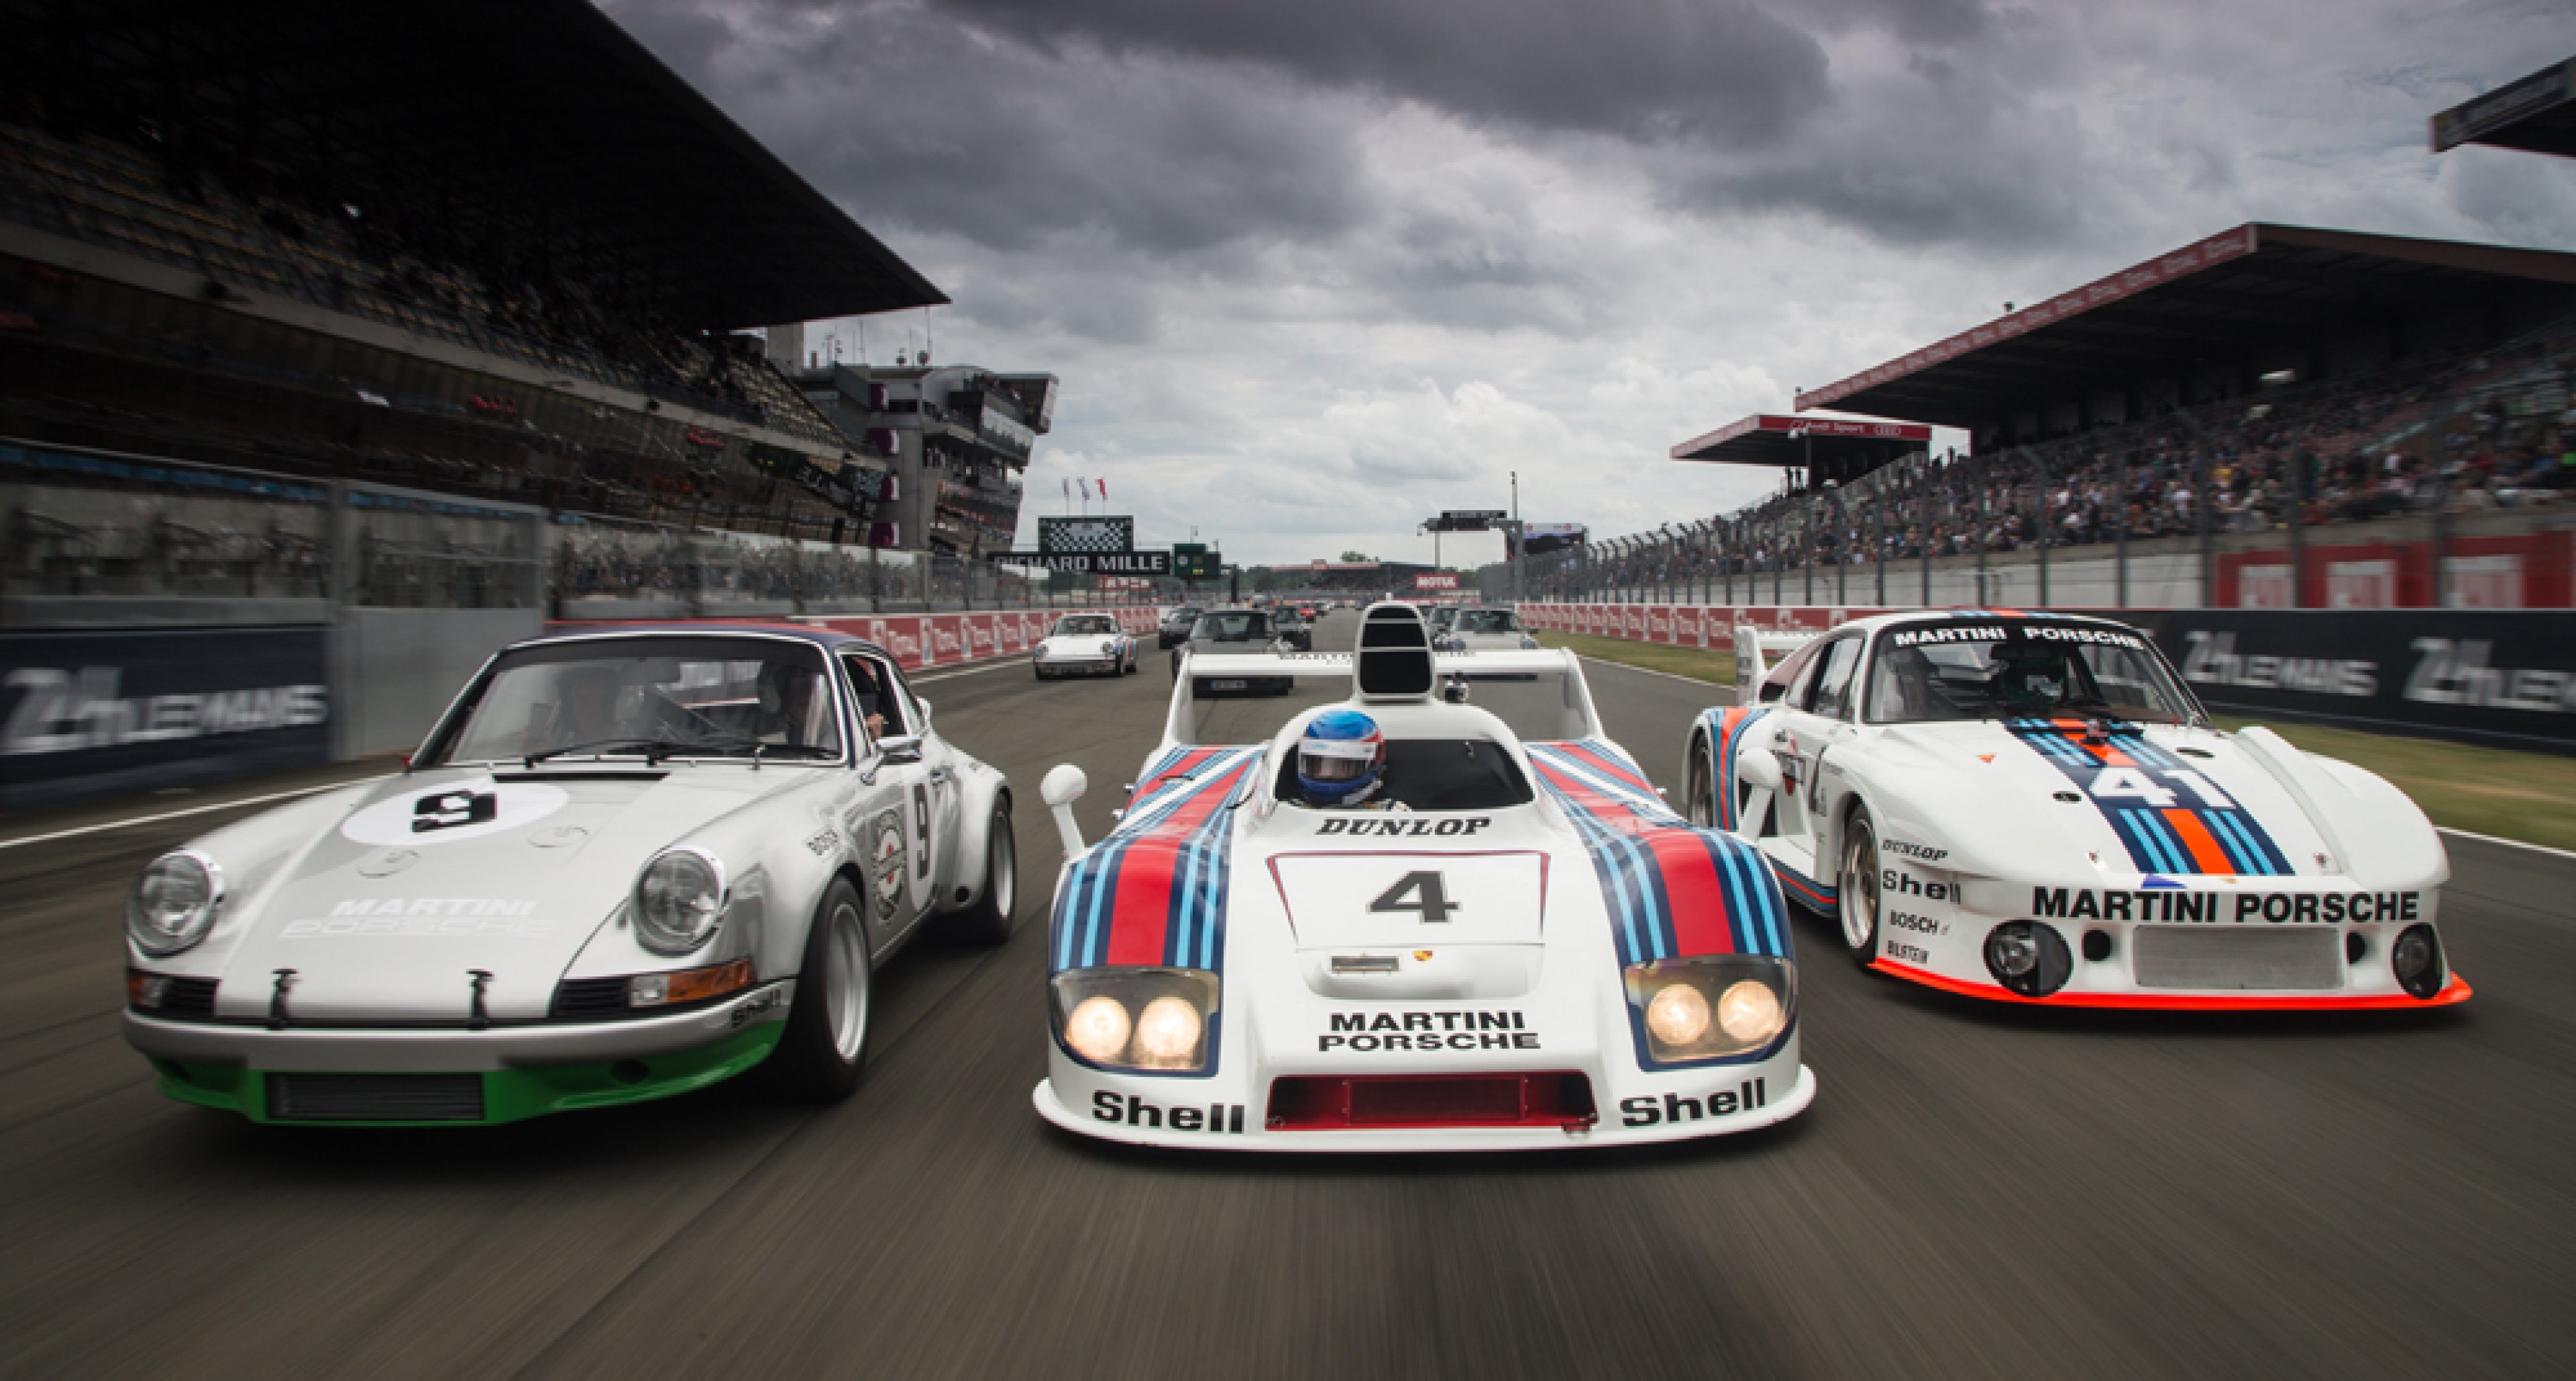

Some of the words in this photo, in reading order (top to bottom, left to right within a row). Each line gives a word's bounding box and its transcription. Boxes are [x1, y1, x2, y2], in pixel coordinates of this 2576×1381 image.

[1097, 556, 1165, 570] MILLE
[1416, 575, 1456, 588] MOTUL
[1895, 626, 2007, 646] MARTINI
[2023, 626, 2145, 650] PORSCHE
[2090, 767, 2235, 808] 41
[411, 788, 498, 834] 9
[913, 782, 930, 882] 9
[1314, 816, 1491, 836] DUNLOP
[1881, 839, 1948, 860] DUNLOP
[1366, 870, 1463, 924] 4
[1882, 868, 1961, 905] Shell
[330, 899, 537, 917] MARTINI
[2033, 886, 2215, 922] MARTINI
[2235, 891, 2419, 923] PORSCHE
[280, 919, 558, 939] PORSCHE
[1889, 909, 1941, 935] BOSCH
[731, 988, 782, 1029] Shell
[1330, 1011, 1525, 1031] MARTINI
[1318, 1032, 1542, 1052] PORSCHE
[1091, 1088, 1244, 1134] Shell
[1619, 1078, 1767, 1127] Shell
